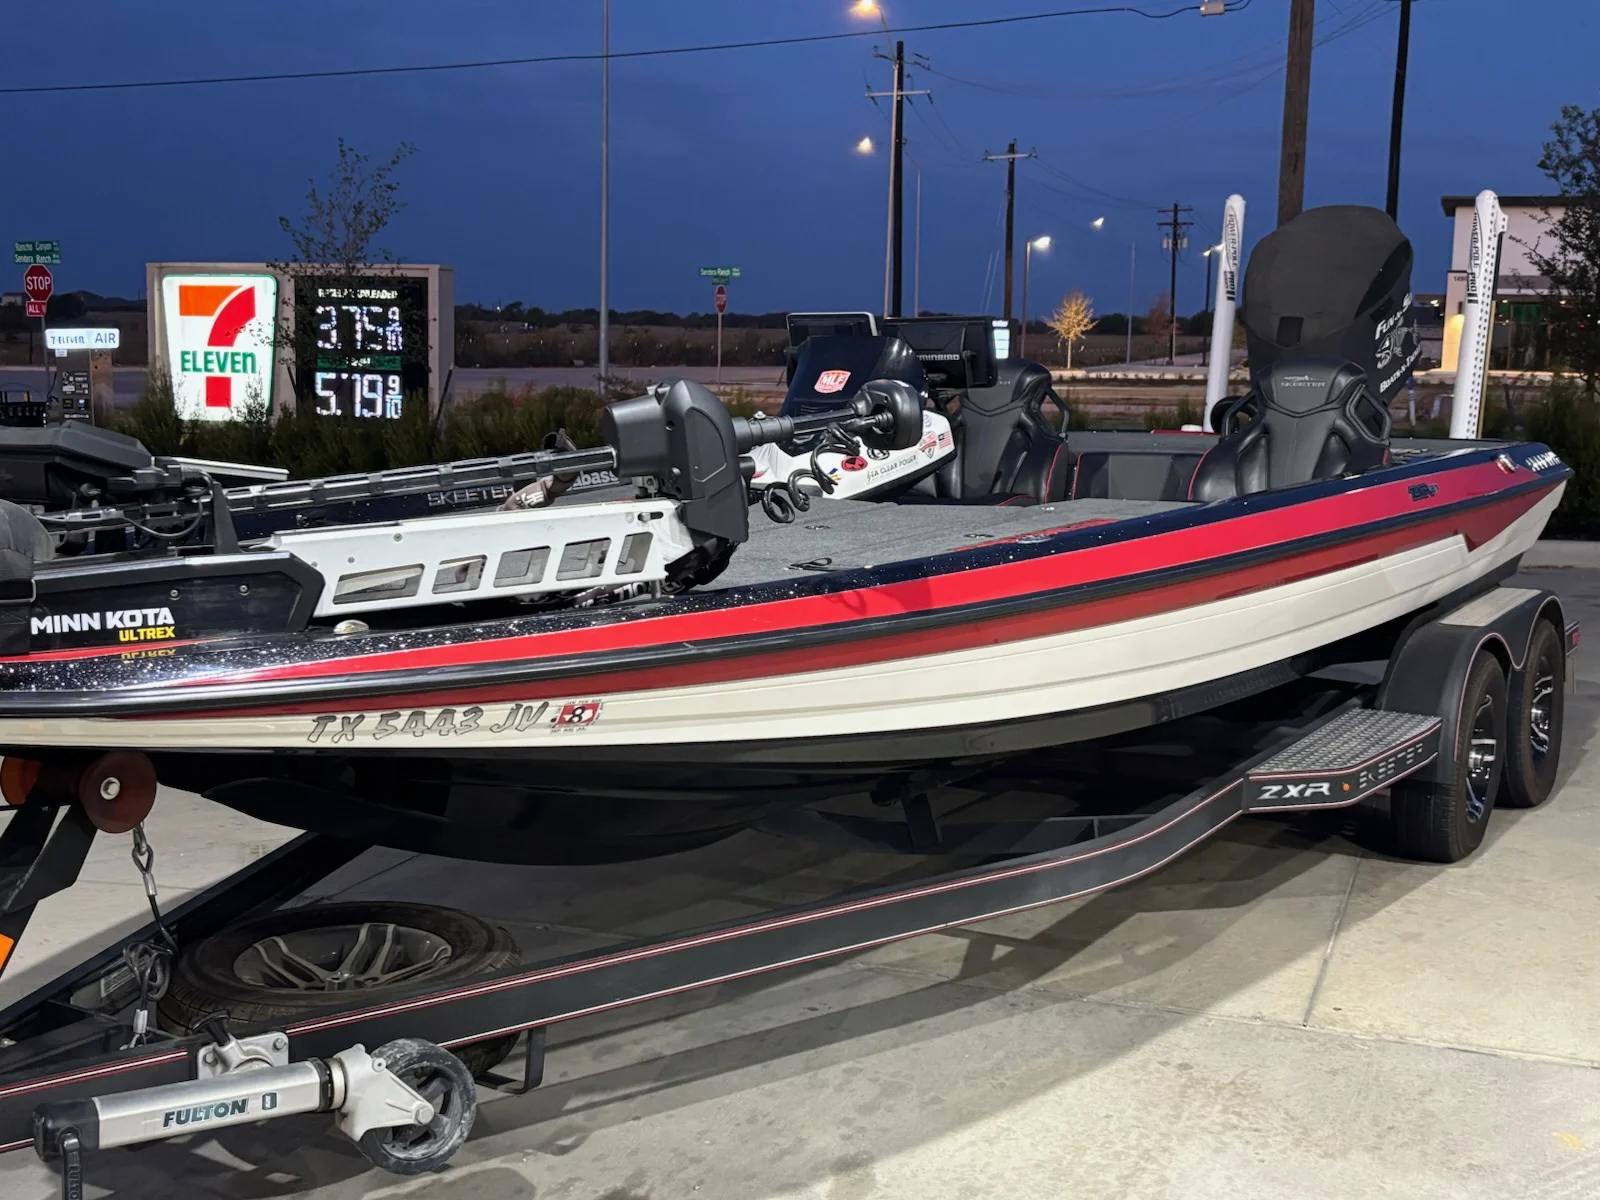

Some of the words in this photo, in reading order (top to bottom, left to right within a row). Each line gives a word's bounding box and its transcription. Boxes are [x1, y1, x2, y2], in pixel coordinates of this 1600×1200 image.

[15, 243, 33, 251] Rancho
[35, 242, 52, 252] Canyon
[1228, 213, 1238, 268] POWER-POLE
[15, 254, 33, 262] Sendera
[36, 255, 51, 263] Ranch
[26, 276, 51, 290] STOP
[1469, 272, 1477, 292] PRO
[28, 304, 40, 313] ALL
[95, 332, 117, 344] AIR
[821, 374, 848, 386] MLF
[880, 461, 898, 475] CLEAR
[900, 453, 917, 467] POWER
[428, 484, 515, 507] SKEETER
[31, 612, 101, 635] MINN
[105, 607, 175, 630] KOTA
[119, 626, 176, 642] ULTREX
[308, 714, 365, 744] TX
[373, 706, 484, 740] 5443
[490, 702, 549, 733] JV
[568, 706, 585, 723] 8
[1257, 782, 1331, 799] ZXR
[163, 1099, 249, 1128] FULTON
